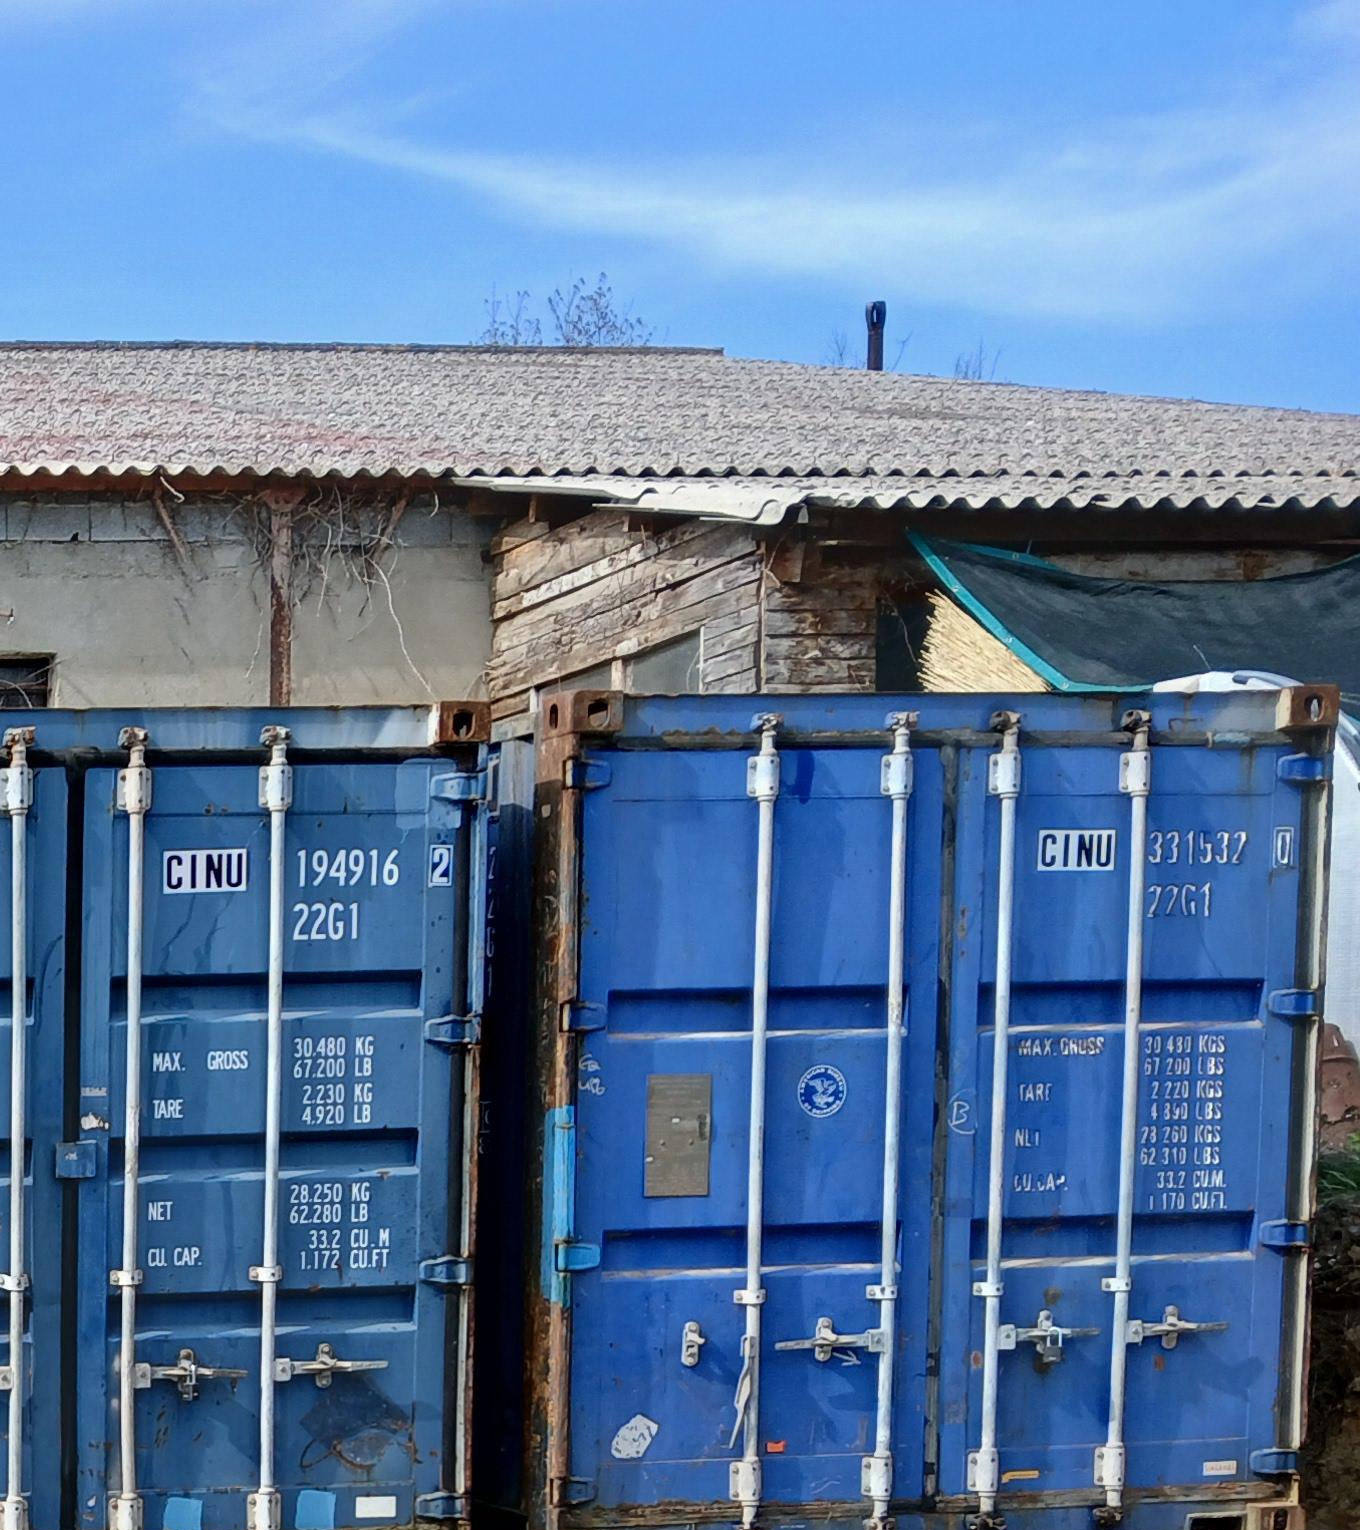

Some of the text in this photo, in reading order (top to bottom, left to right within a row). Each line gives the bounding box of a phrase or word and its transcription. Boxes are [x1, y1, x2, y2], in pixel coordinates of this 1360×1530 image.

[1041, 833, 1113, 868] CINU
[166, 847, 451, 890] CINU 194916 2
[292, 901, 359, 941] 22G1
[1198, 1034, 1226, 1053] KGS
[152, 1036, 374, 1073] MAX. GROSS 30.480 KG
[293, 1057, 373, 1079] 67.200 LB
[1197, 1056, 1225, 1075] LBS
[1196, 1080, 1224, 1098] KGS
[153, 1083, 373, 1119] TARE 2.230 KG
[1195, 1102, 1222, 1120] LBS
[301, 1105, 371, 1125] 4.920 LB
[1194, 1125, 1222, 1144] KGS
[1193, 1146, 1220, 1165] LBS
[1156, 1171, 1186, 1189] 33.2
[147, 1182, 371, 1221] NET 28.250 KG
[289, 1203, 369, 1224] 62.280 LB
[308, 1229, 341, 1249] 33.2
[299, 1249, 390, 1270] 1.172 CU.FT
